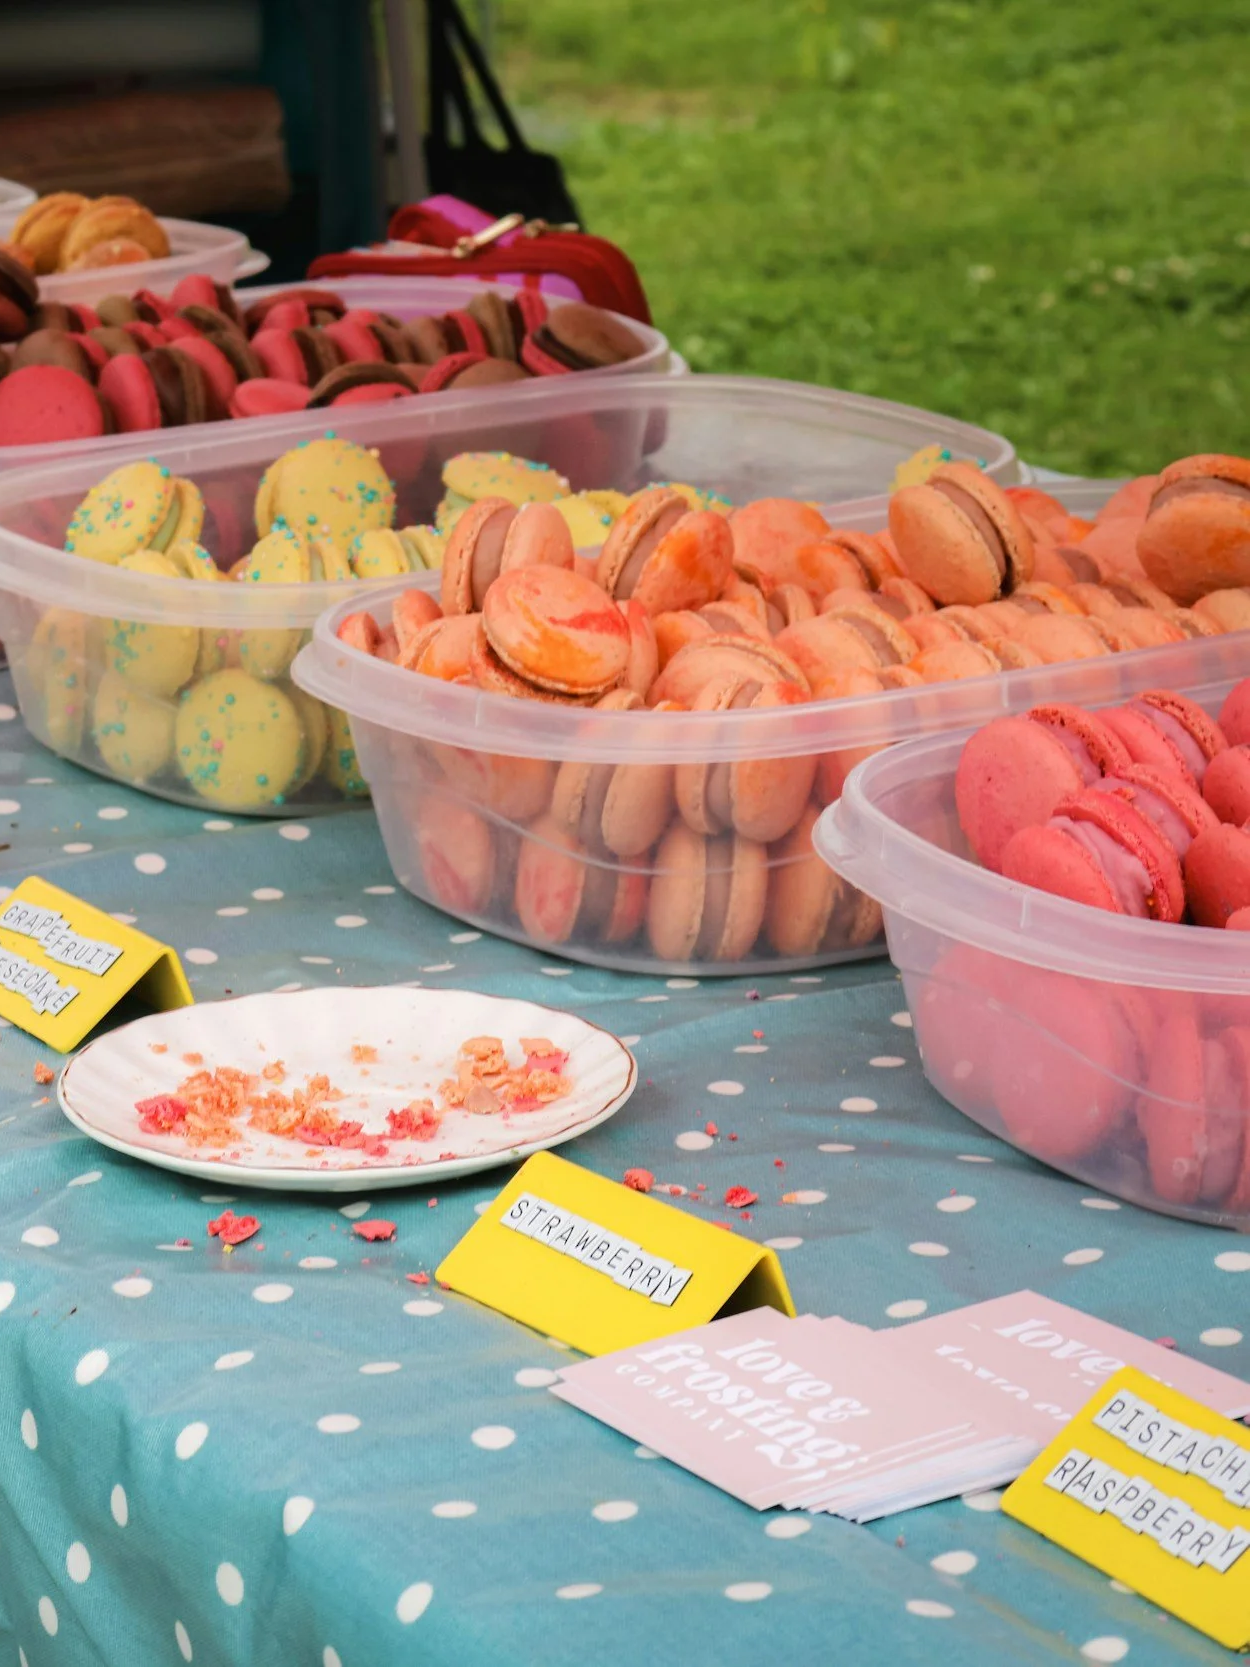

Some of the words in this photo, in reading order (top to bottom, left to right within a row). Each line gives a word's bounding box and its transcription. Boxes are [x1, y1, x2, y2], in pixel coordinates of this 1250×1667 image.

[2, 904, 115, 969] GRAPEFRUIT
[509, 1198, 684, 1296] STRAWBERRY
[994, 1319, 1127, 1375] love
[1053, 1456, 1244, 1558] RASPBERRY
